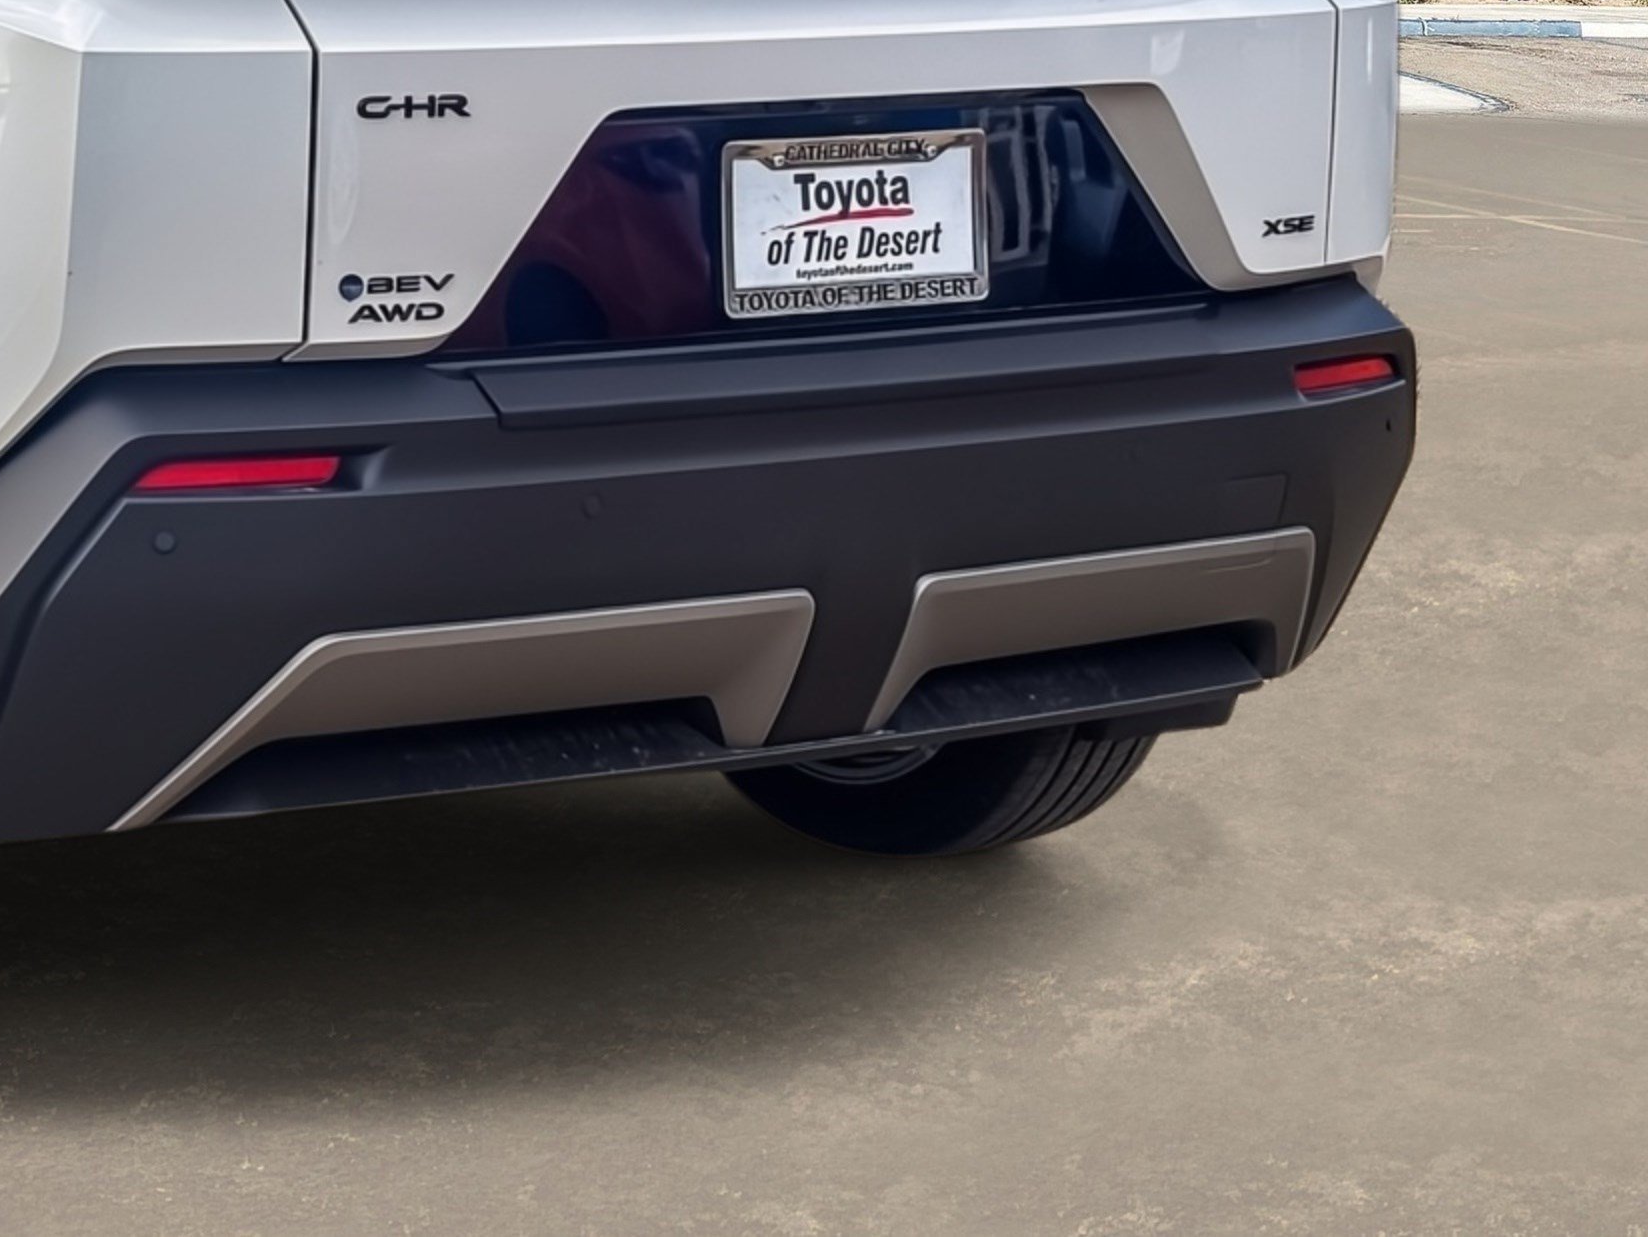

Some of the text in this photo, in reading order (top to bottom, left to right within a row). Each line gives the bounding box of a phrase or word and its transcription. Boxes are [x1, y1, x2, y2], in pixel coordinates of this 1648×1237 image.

[356, 94, 471, 119] C-HR
[785, 138, 925, 161] CATHEDRAL CITY
[793, 170, 910, 216] Toyota
[1261, 214, 1315, 237] XSE
[767, 222, 942, 267] of The Desert
[367, 273, 455, 295] BEV
[736, 277, 978, 312] TOYOTA OF THE DESERT
[347, 303, 445, 324] AWD
